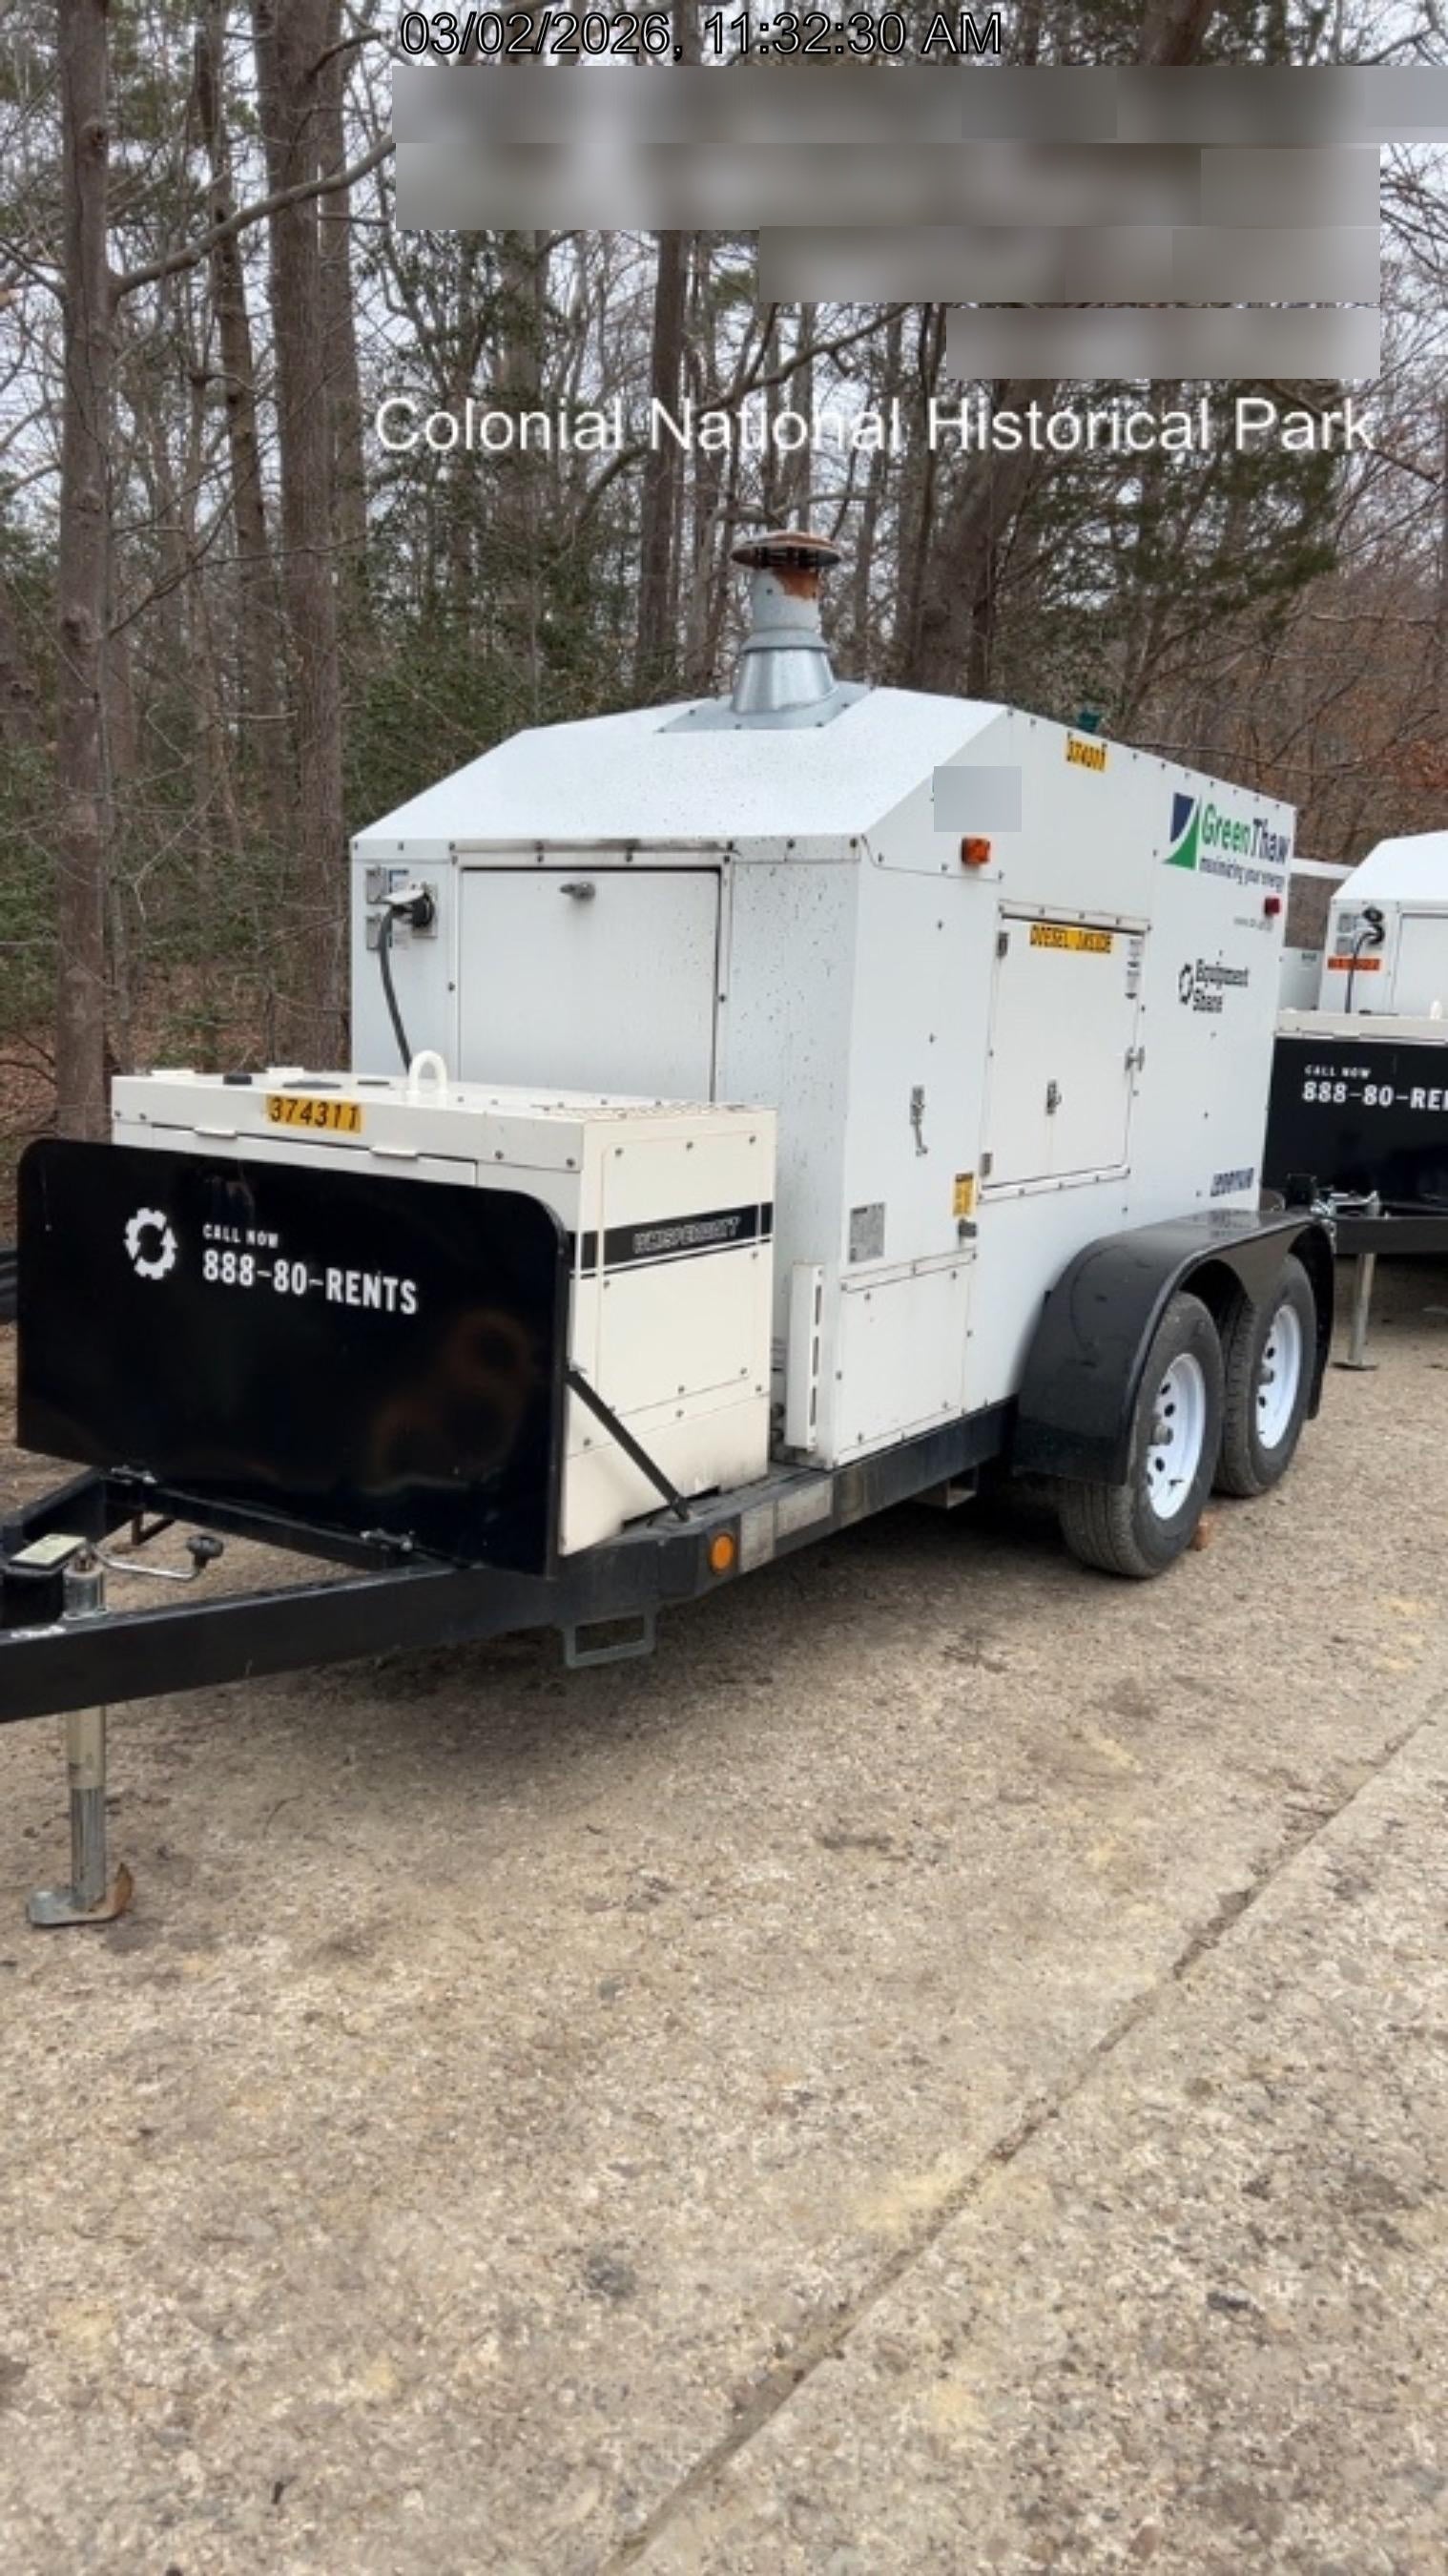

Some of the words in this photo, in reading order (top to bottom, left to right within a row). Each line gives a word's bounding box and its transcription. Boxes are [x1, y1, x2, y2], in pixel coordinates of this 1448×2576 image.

[1304, 1064, 1336, 1077] CALL
[1341, 1067, 1372, 1079] NOW
[270, 1095, 359, 1131] 374311
[202, 1222, 240, 1243] CALL
[246, 1230, 279, 1249] NOW
[202, 1248, 419, 1315] 888-80-RENTS
